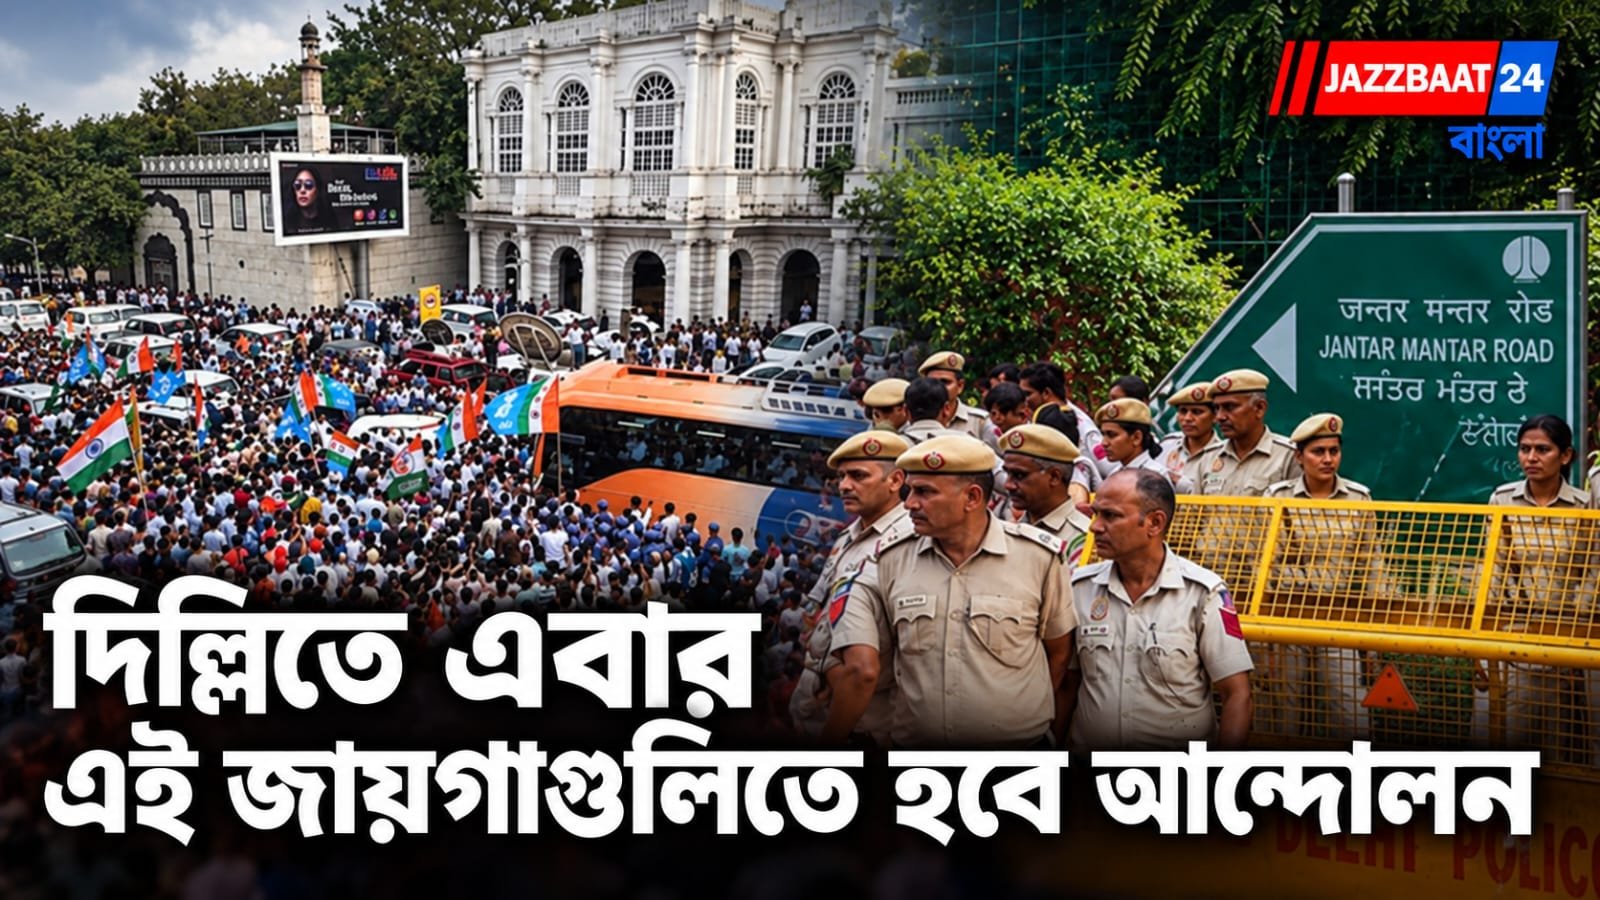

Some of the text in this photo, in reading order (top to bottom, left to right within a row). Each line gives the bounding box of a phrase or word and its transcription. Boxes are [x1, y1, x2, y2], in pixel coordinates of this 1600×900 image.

[1338, 290, 1553, 323] जन्तर मन्तर रोड
[1319, 335, 1554, 363] JANTAR MANTAR ROAD
[1452, 820, 1600, 898] POLIC
